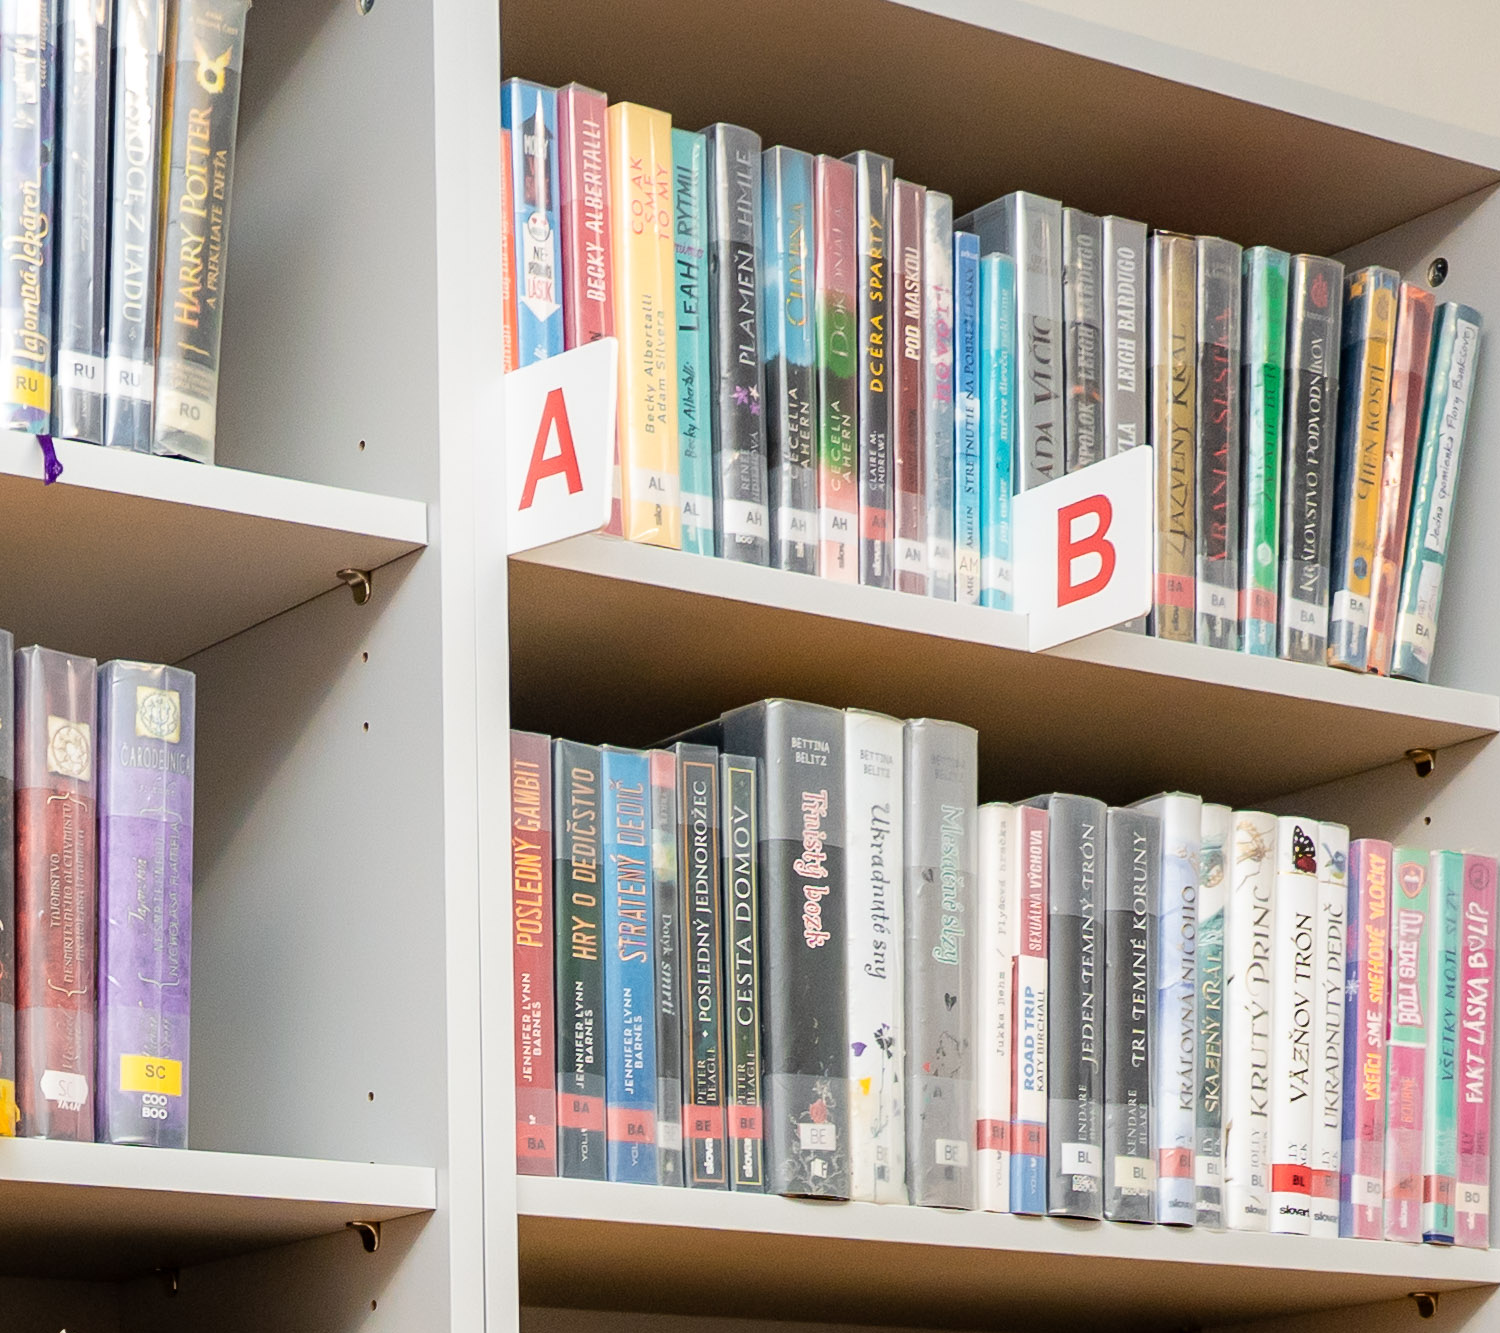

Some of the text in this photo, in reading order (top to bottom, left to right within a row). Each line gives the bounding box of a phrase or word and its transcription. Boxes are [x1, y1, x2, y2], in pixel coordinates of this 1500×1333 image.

[175, 110, 214, 329] HARRY POTTER
[582, 119, 606, 302] BECKY ALBERTALLI
[868, 216, 883, 302] SPARTY
[1116, 246, 1136, 393] LEIGH BARDUGO
[518, 390, 586, 511] A
[1055, 493, 1115, 608] B
[513, 758, 542, 949] POSLEDNÝ GAMBIT
[1249, 885, 1272, 1115] KRUTÝ PRINC
[142, 1093, 168, 1106] COO
[142, 1106, 168, 1119] BOO
